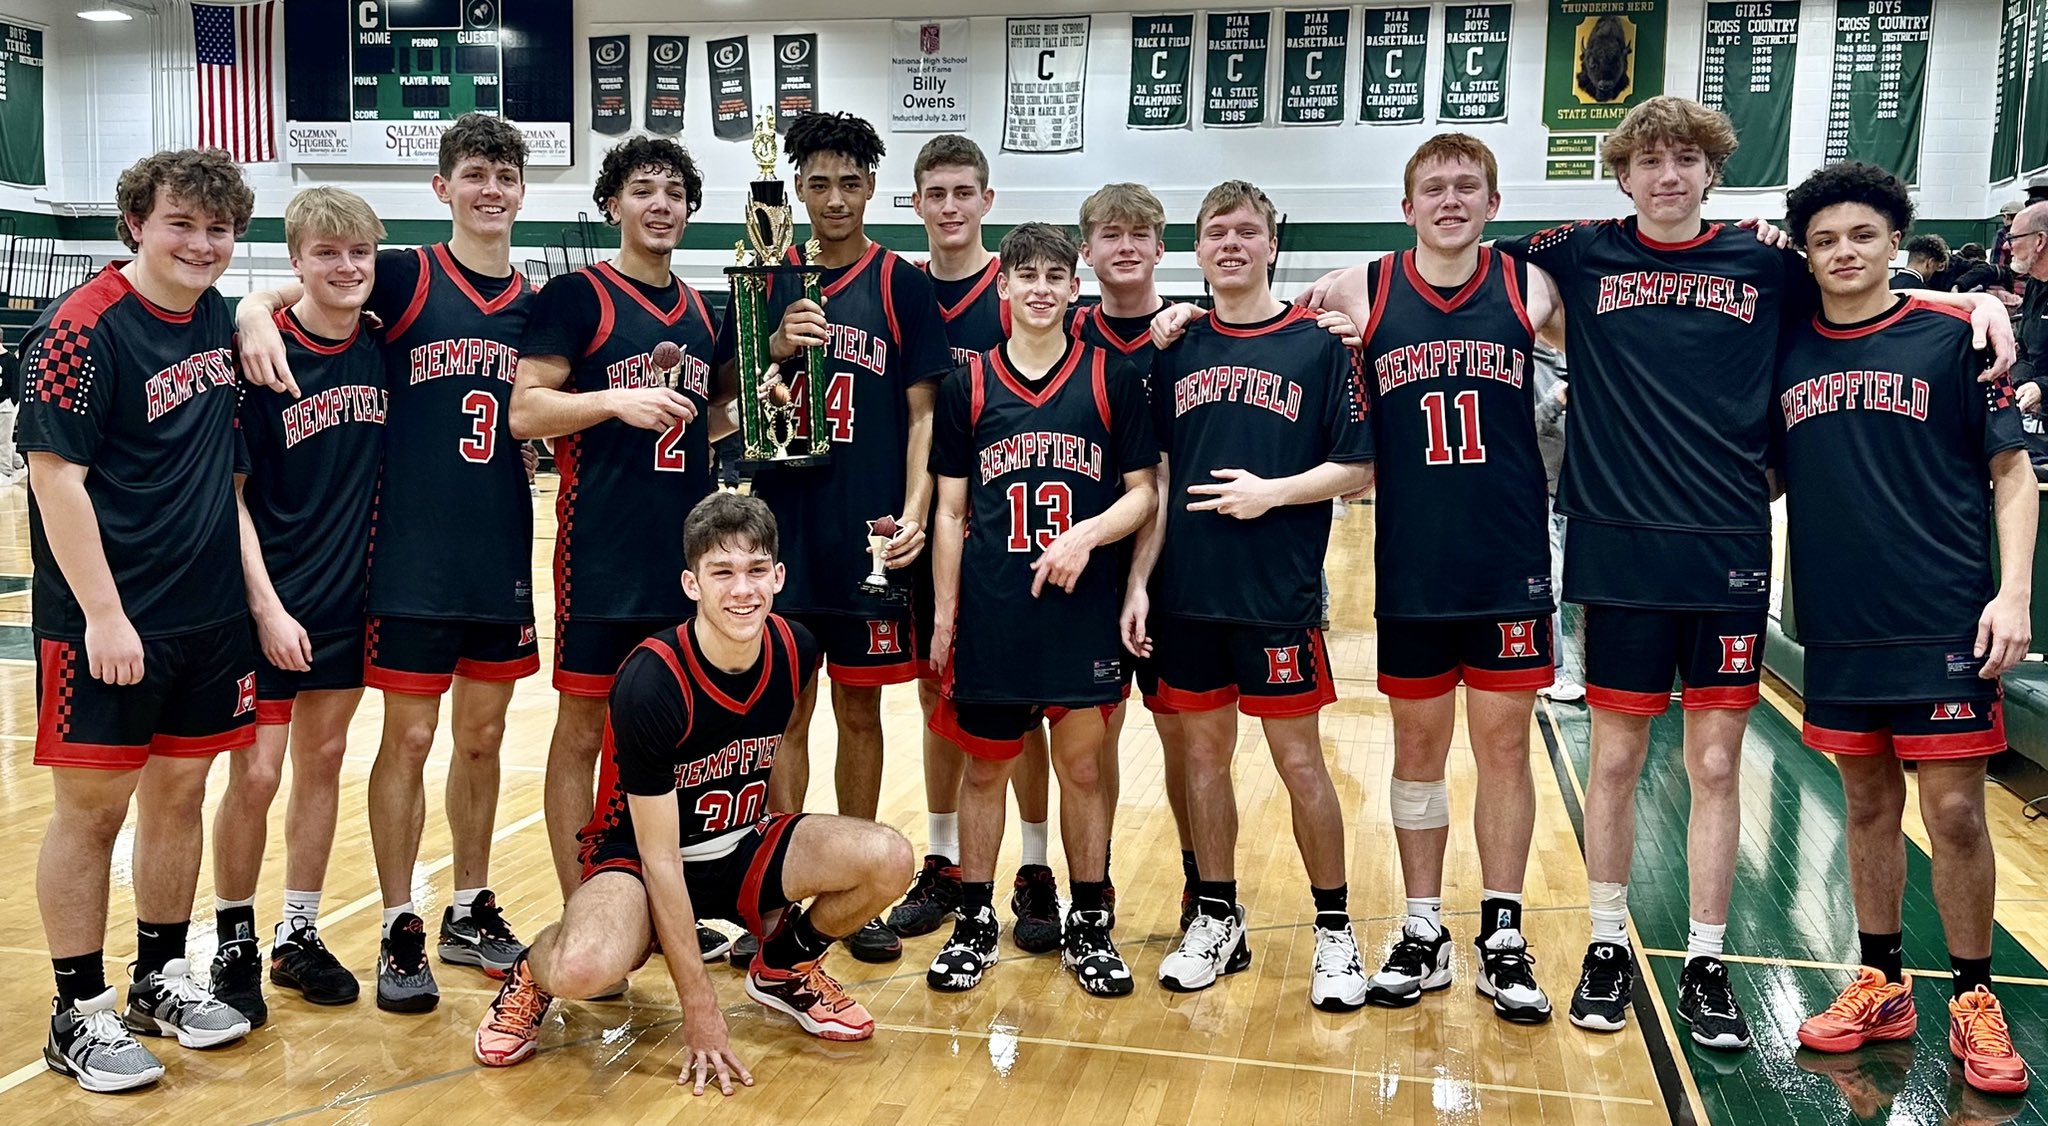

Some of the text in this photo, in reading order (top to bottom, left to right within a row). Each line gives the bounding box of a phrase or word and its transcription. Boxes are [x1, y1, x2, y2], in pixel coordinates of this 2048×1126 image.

[1465, 8, 1490, 19] PIAA
[1561, 2, 1654, 13] THUNDERING HERD
[1736, 4, 1772, 17] GIRLS
[1868, 1, 1902, 14] BOYS
[358, 1, 378, 28] C
[1305, 13, 1328, 24] PIAA
[1385, 11, 1410, 22] PIAA
[1226, 16, 1249, 26] PIAA
[1464, 20, 1489, 31] BOYS
[1708, 19, 1797, 33] CROSS COUNTRY
[1837, 16, 1929, 31] CROSS COUNTRY
[10, 26, 27, 41] BOYS
[1011, 23, 1085, 35] CARLISLE HIGH SCHOOL
[1150, 24, 1173, 34] PIAA
[1225, 27, 1249, 38] BOYS
[1304, 25, 1328, 35] BOYS
[1384, 23, 1408, 34] BOYS
[360, 32, 391, 44] HOME
[457, 31, 493, 44] GUEST
[1134, 37, 1158, 48] TRACK
[1168, 36, 1190, 47] FIELD
[1287, 36, 1345, 48] BASKETBALL
[1366, 34, 1426, 46] BASKETBALL
[1447, 32, 1507, 44] BASKETBALL
[1752, 34, 1797, 45] DISTRICT III
[1882, 31, 1928, 42] DISTRICT III
[5, 38, 32, 55] TENNIS
[412, 38, 438, 48] PERIOD
[1209, 39, 1266, 50] BASKETBALL
[1385, 49, 1402, 78] C
[1466, 46, 1484, 76] C
[1856, 54, 1875, 62] 2020
[1038, 50, 1055, 80] C
[1151, 51, 1167, 79] C
[1227, 54, 1244, 82] C
[1306, 51, 1322, 80] C
[1855, 63, 1873, 71] 2021
[1881, 63, 1901, 71] 1987
[354, 76, 378, 86] FOULS
[400, 76, 451, 86] PLAYER FOUL
[474, 76, 498, 86] FOULS
[913, 76, 946, 94] Billy
[1450, 81, 1499, 92] 4A STATE
[1880, 82, 1898, 90] 1991
[1136, 84, 1182, 94] 3A STATE
[1212, 87, 1258, 98] 4A STATE
[1290, 84, 1338, 96] 4A STATE
[1369, 83, 1418, 94] 4A STATE
[903, 94, 955, 108] Owens
[1133, 95, 1182, 106] CHAMPIONS
[1287, 96, 1338, 108] CHAMPIONS
[1366, 95, 1418, 106] CHAMPIONS
[1447, 93, 1500, 104] CHAMPIONS
[1833, 92, 1849, 100] 1991
[1210, 98, 1259, 110] CHAMPIONS
[1878, 101, 1898, 109] 1996
[354, 110, 378, 119] SCORE
[413, 110, 440, 119] MATCH
[1145, 107, 1170, 118] 2017
[1220, 110, 1246, 121] 1985
[1299, 108, 1325, 119] 1986
[1378, 107, 1405, 118] 1987
[1459, 105, 1486, 116] 1988
[1558, 108, 1629, 119] STATE CHAMPI
[1831, 111, 1850, 119] 1995
[925, 114, 940, 122] July
[942, 114, 948, 122] 2,
[290, 129, 337, 147] SALZMANN
[1828, 130, 1848, 138] 1997
[298, 139, 348, 153] HUGHES, P.C.
[1827, 148, 1847, 156] 2013
[1596, 272, 1760, 325] HEMPFIELD
[822, 324, 887, 376] FIELD
[410, 338, 518, 385] HEMPFIE
[1374, 339, 1526, 397] HEMPFIELD
[1174, 365, 1303, 422] HEMPFIELD
[790, 371, 854, 442] 44
[1780, 370, 1931, 432] HEMPFIELD
[459, 389, 498, 464] 3
[1420, 389, 1486, 466] 11
[654, 416, 685, 472] 2
[978, 432, 1102, 486] HEMPFIELD
[1006, 481, 1073, 553] 13
[865, 619, 901, 655] H
[1497, 619, 1539, 659] H
[1717, 633, 1758, 674] H
[1264, 645, 1304, 684] H
[674, 734, 782, 789] HEMPFIE
[694, 780, 766, 832] 30
